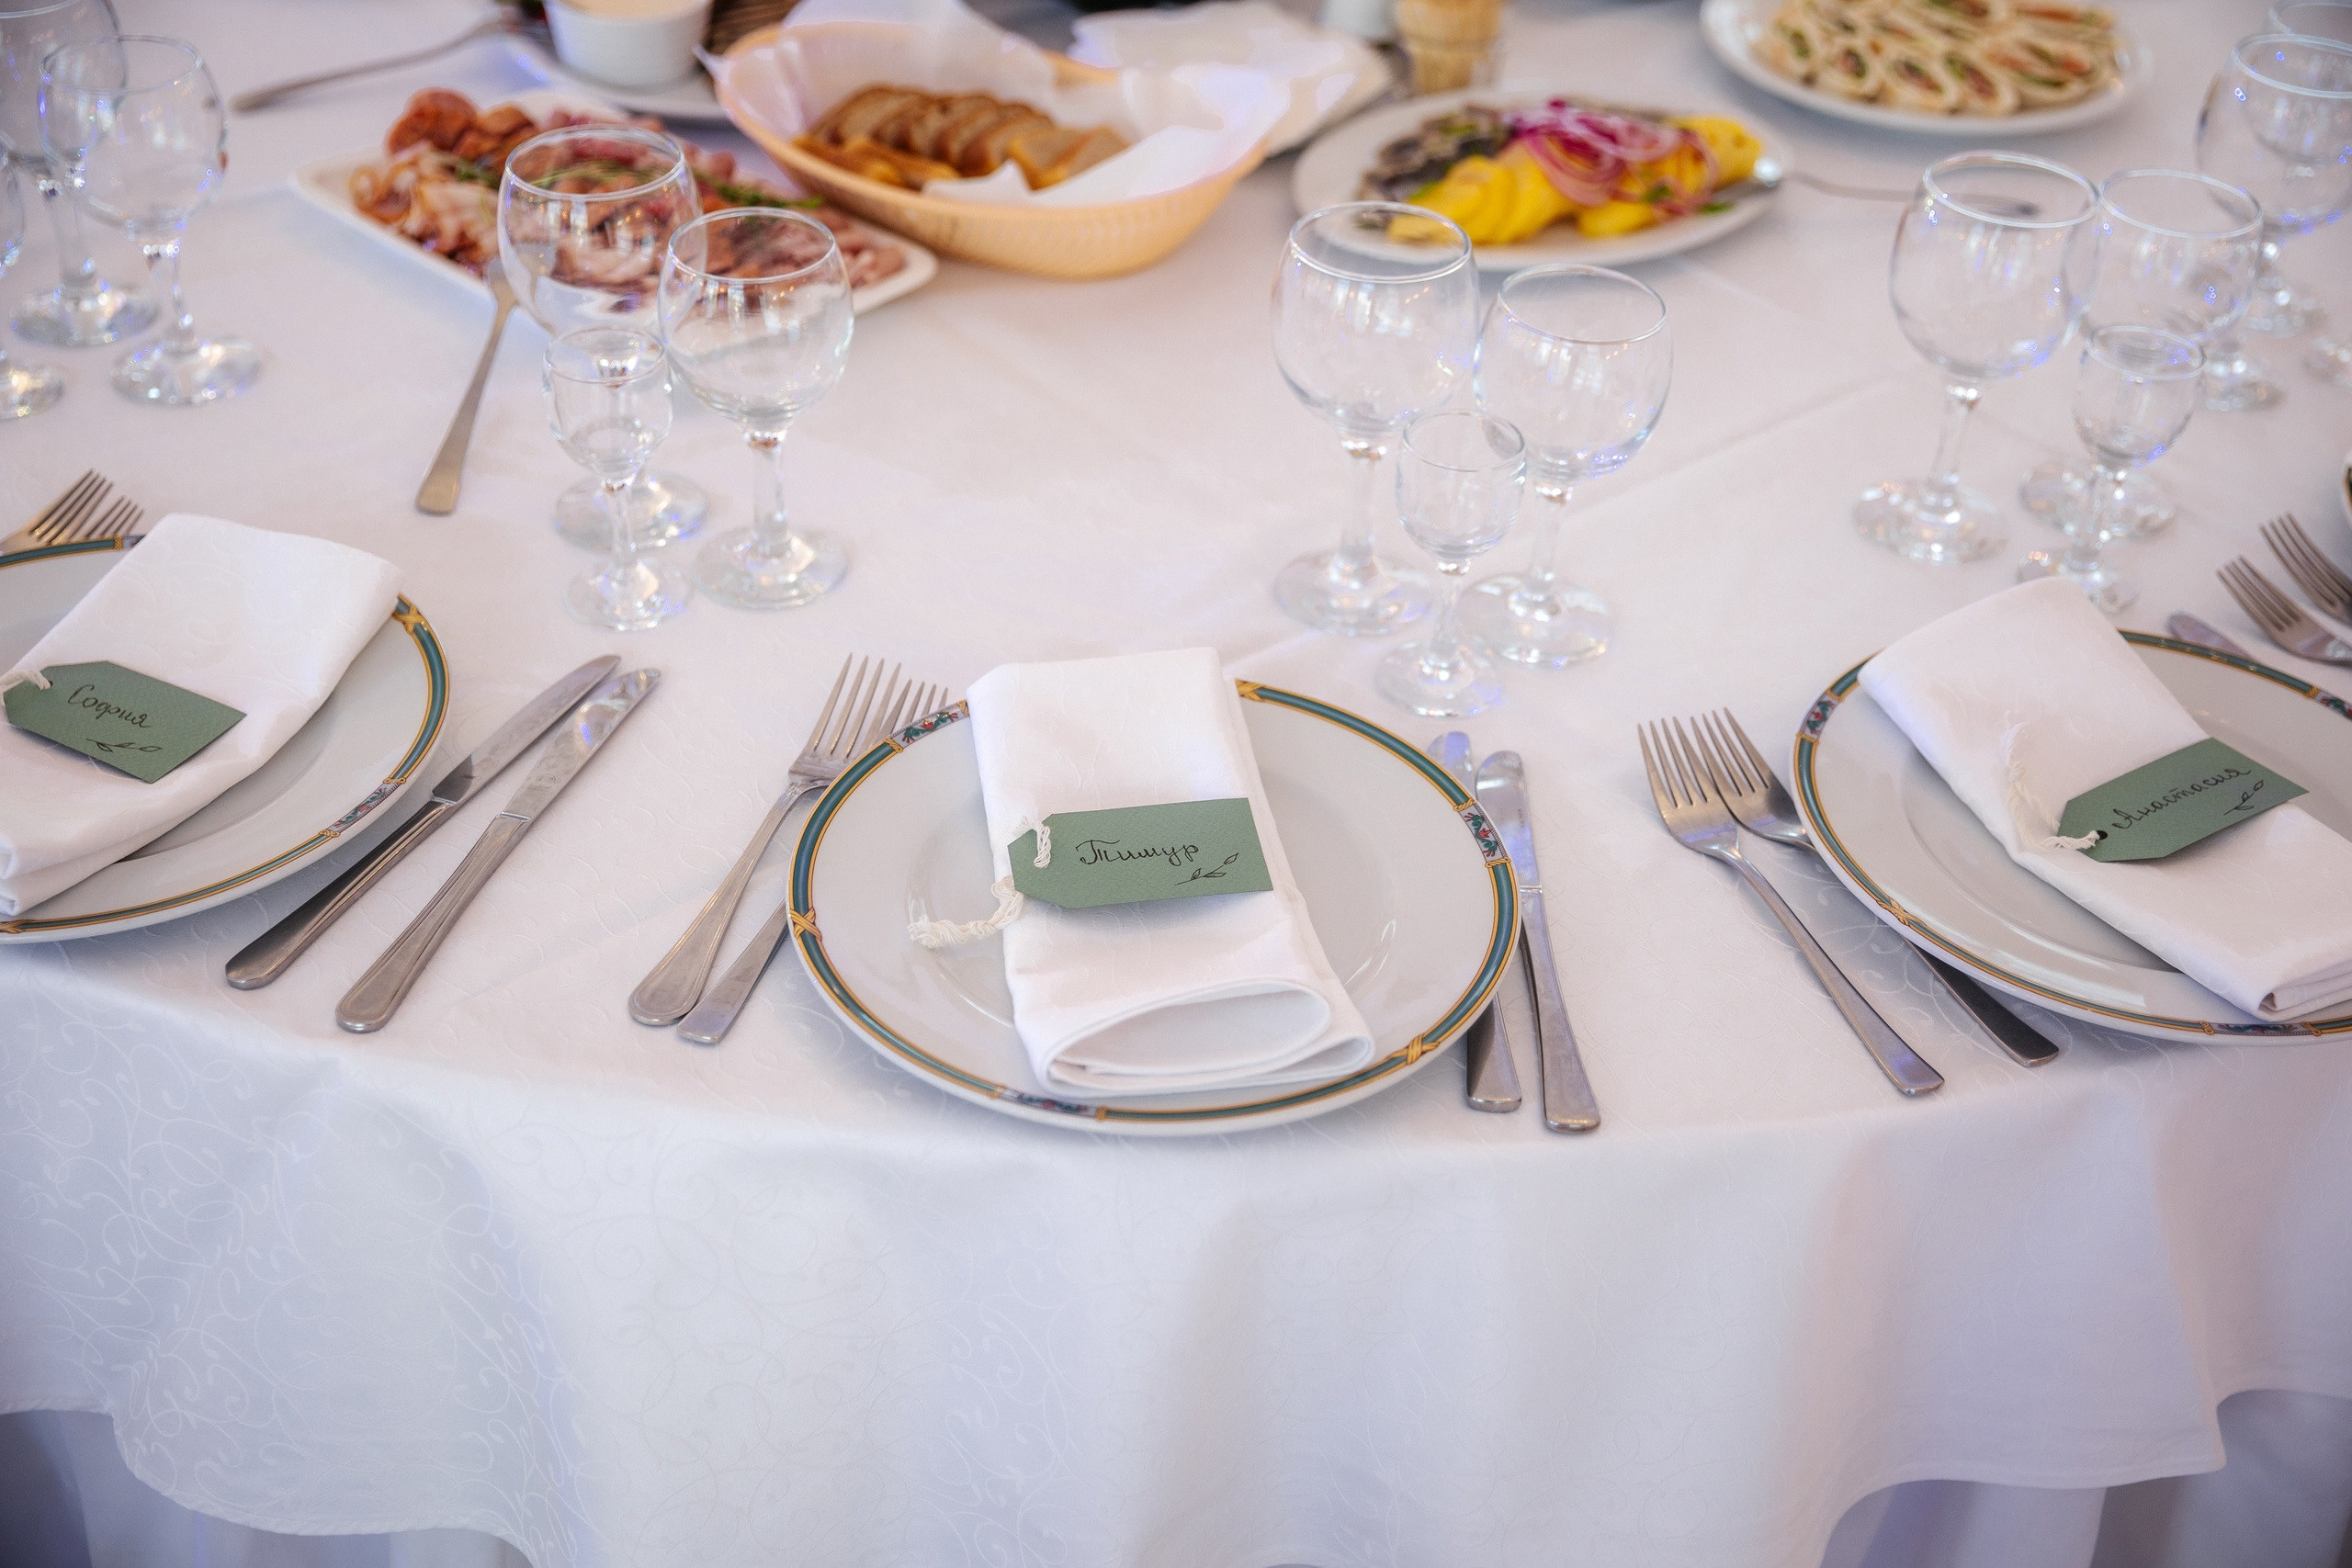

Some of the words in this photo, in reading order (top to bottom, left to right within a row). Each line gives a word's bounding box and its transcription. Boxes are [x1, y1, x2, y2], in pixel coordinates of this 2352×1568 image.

[68, 684, 152, 728] София
[2111, 767, 2252, 829] Анастасия
[1075, 839, 1200, 867] Тимур
